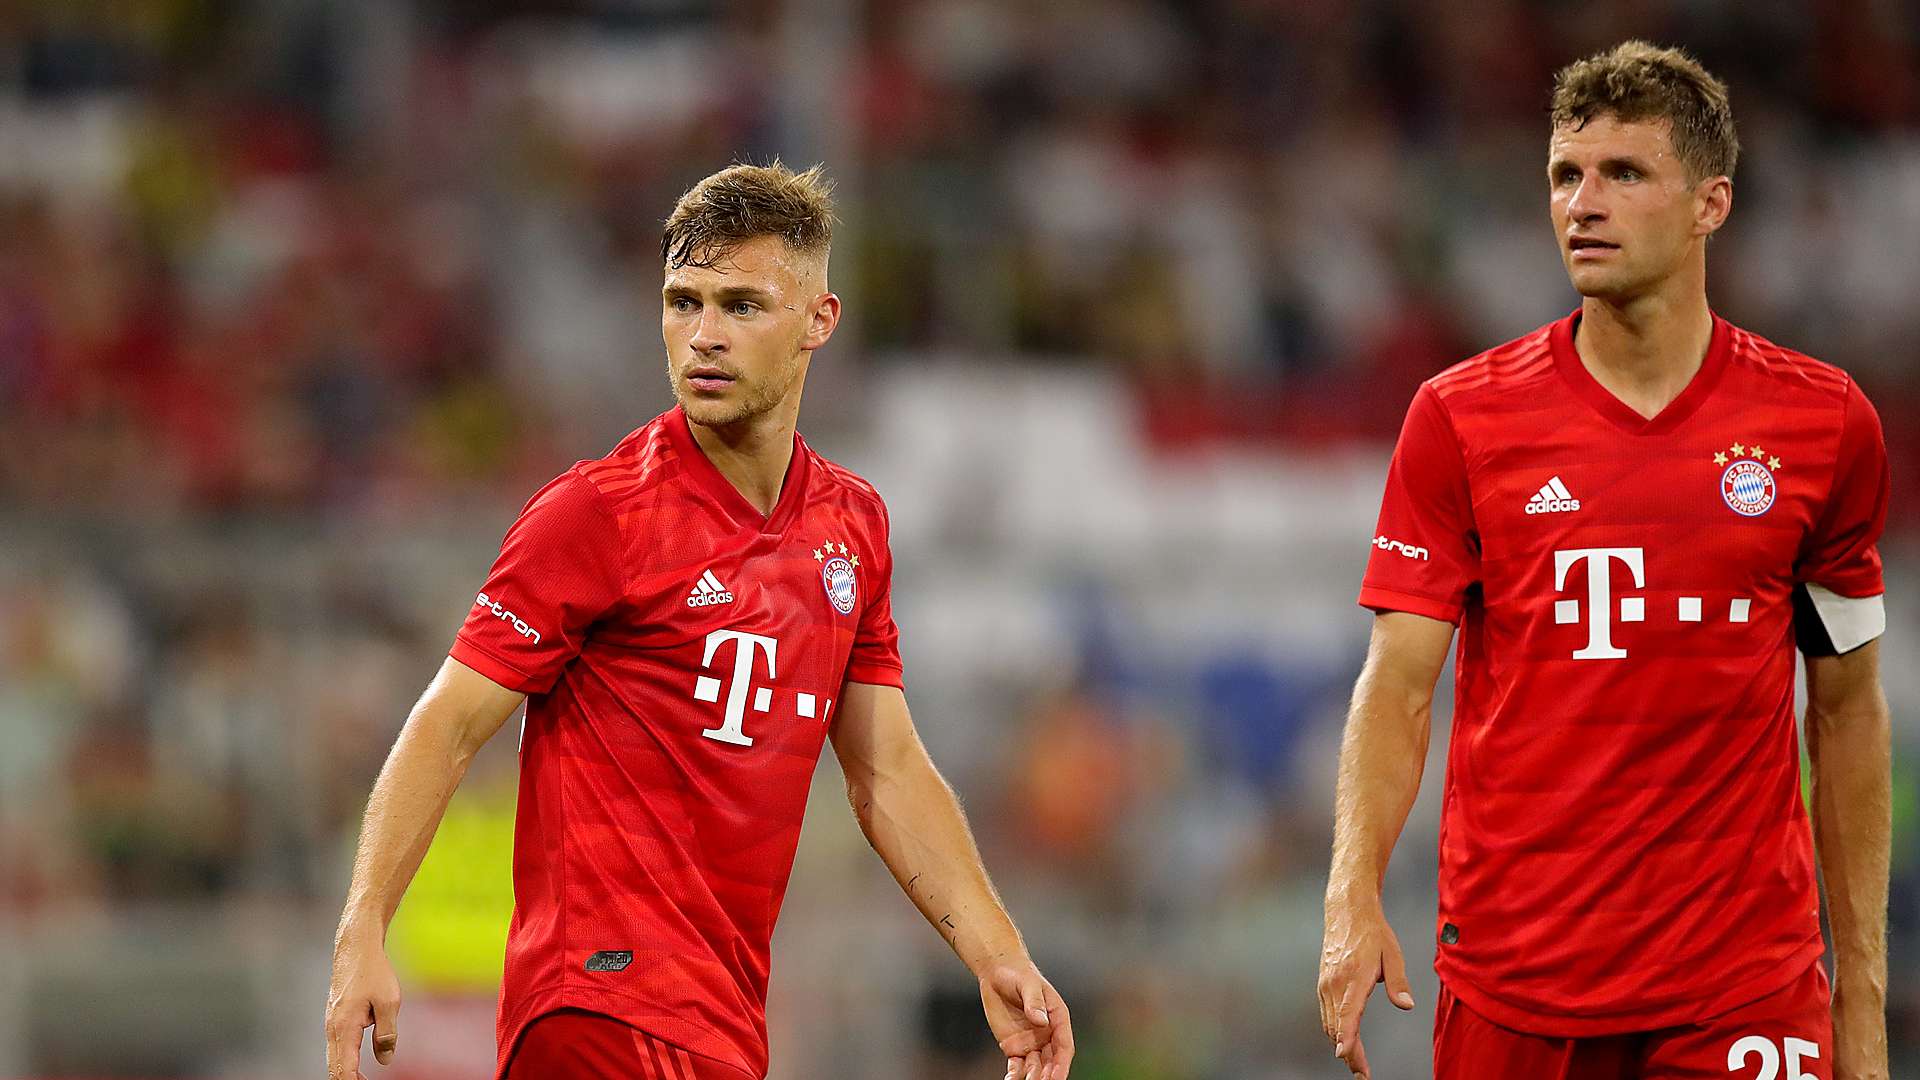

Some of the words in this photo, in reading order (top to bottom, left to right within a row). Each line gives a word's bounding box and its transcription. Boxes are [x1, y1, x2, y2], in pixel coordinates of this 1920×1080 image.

[1726, 469, 1737, 484] FC
[1736, 464, 1772, 486] BAYERN
[1524, 498, 1581, 515] adidas
[686, 591, 734, 607] adidas
[475, 592, 541, 645] e-tron
[1727, 1035, 1820, 1080] 25
